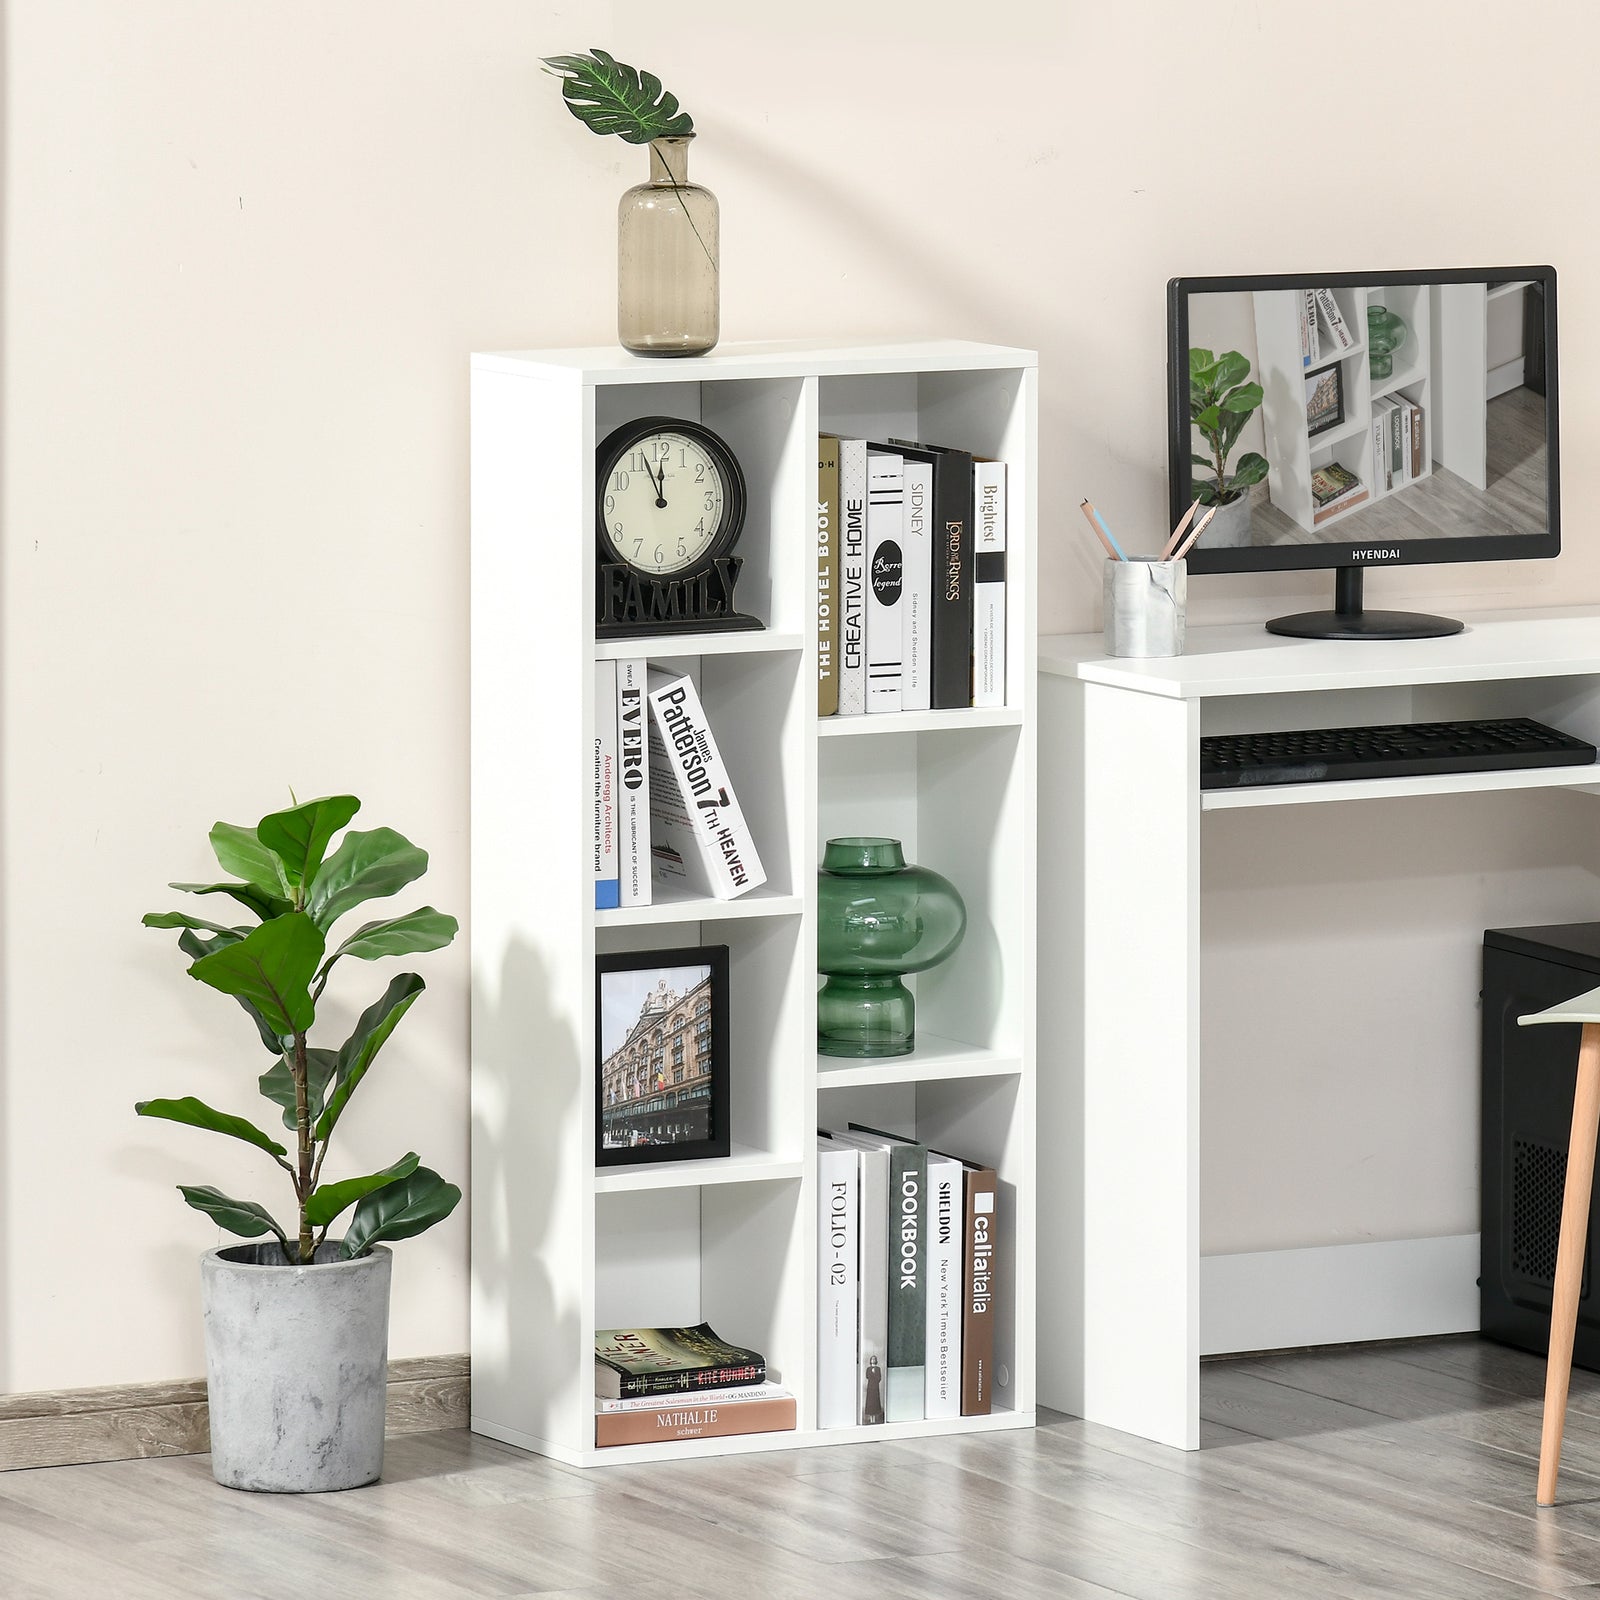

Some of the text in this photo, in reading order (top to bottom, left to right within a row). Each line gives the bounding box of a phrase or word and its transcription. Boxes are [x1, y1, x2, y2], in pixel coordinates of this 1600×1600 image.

[652, 442, 670, 462] 12
[679, 449, 687, 468] 1
[612, 472, 630, 491] 10
[694, 464, 704, 483] 2
[606, 496, 615, 516] 9
[704, 491, 714, 511] 3
[911, 483, 924, 537] SIDNEY
[980, 485, 998, 542] Brightest
[614, 522, 624, 542] 8
[694, 517, 704, 536] 4
[946, 520, 963, 552] LORD
[633, 538, 644, 558] 7
[654, 544, 664, 564] 6
[676, 537, 686, 556] 5
[1352, 549, 1400, 560] HYENDAI
[601, 555, 744, 624] FAMILY
[818, 501, 830, 680] THE HOTEL BOOK
[846, 499, 862, 669] CREATIVE HOME
[874, 576, 903, 592] legend
[946, 561, 961, 600] RINGS
[621, 688, 643, 790] EVERO
[694, 729, 712, 762] James
[603, 755, 612, 802] Anderegg
[658, 686, 712, 796] Patterson
[716, 828, 748, 886] HEAVEN
[632, 855, 638, 864] OF
[830, 1182, 847, 1247] FOLIO
[939, 1182, 950, 1244] SHELDON
[900, 1171, 918, 1289] LOOKBOOK
[830, 1264, 846, 1286] 02
[973, 1216, 992, 1314] caliaitalia
[698, 1370, 718, 1385] KITE
